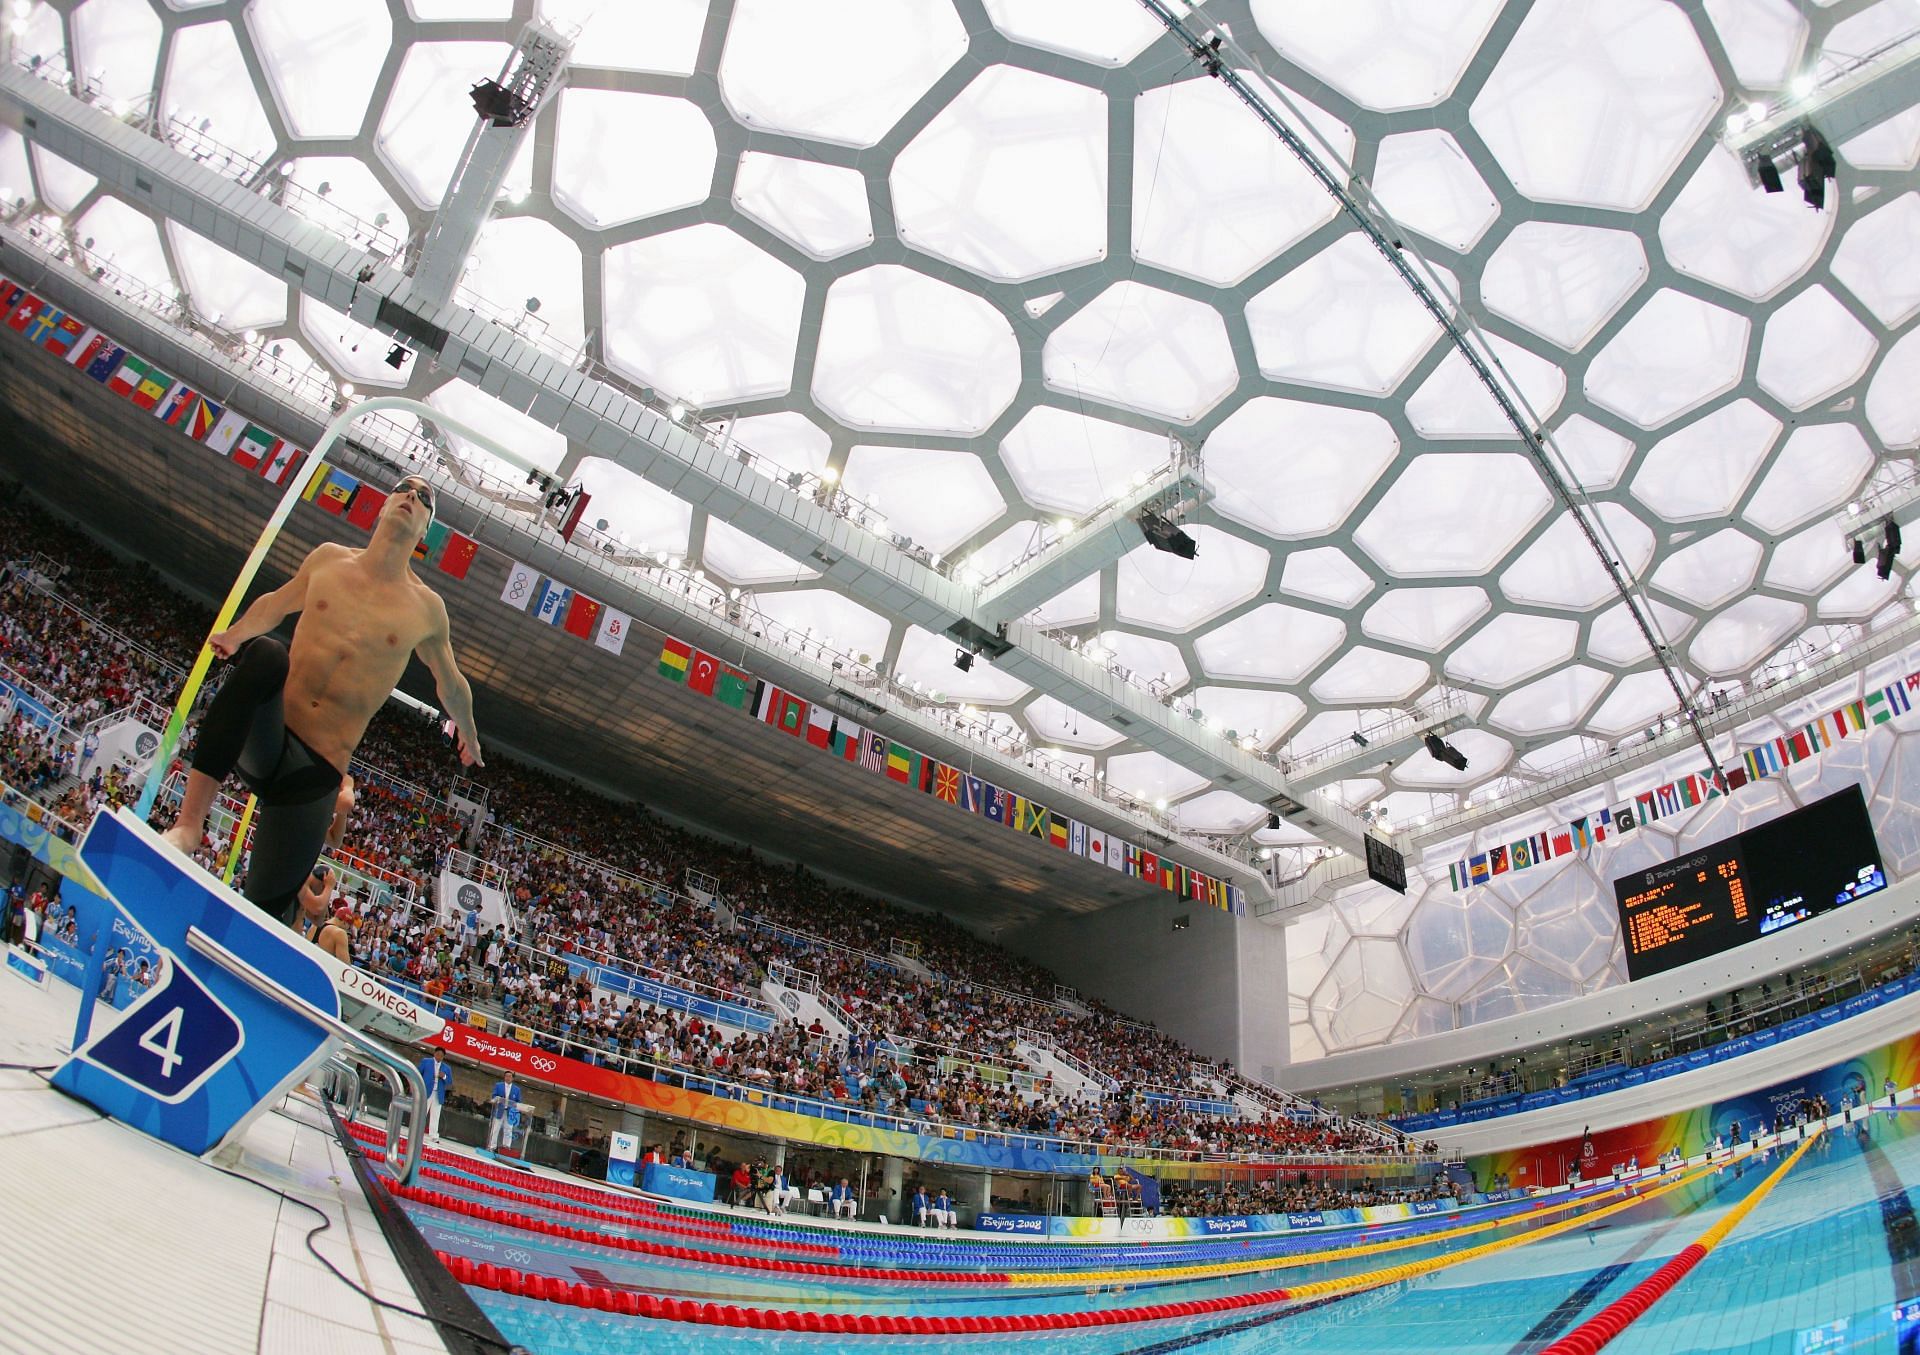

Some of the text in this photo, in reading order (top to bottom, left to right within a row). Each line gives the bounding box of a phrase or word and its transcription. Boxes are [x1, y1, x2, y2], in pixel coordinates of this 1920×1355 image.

[1662, 882, 1674, 891] FLY
[1626, 895, 1658, 908] SEMIFINAL
[112, 918, 152, 954] Beijing
[362, 982, 418, 1023] OMEGA
[138, 1006, 184, 1078] 4
[465, 1036, 522, 1062] Beijing 2008
[668, 1174, 688, 1185] Beijing
[981, 1216, 1042, 1230] Beijing 2008
[1206, 1219, 1247, 1232] Beijing 2008
[1289, 1214, 1322, 1226] Beijing 2008
